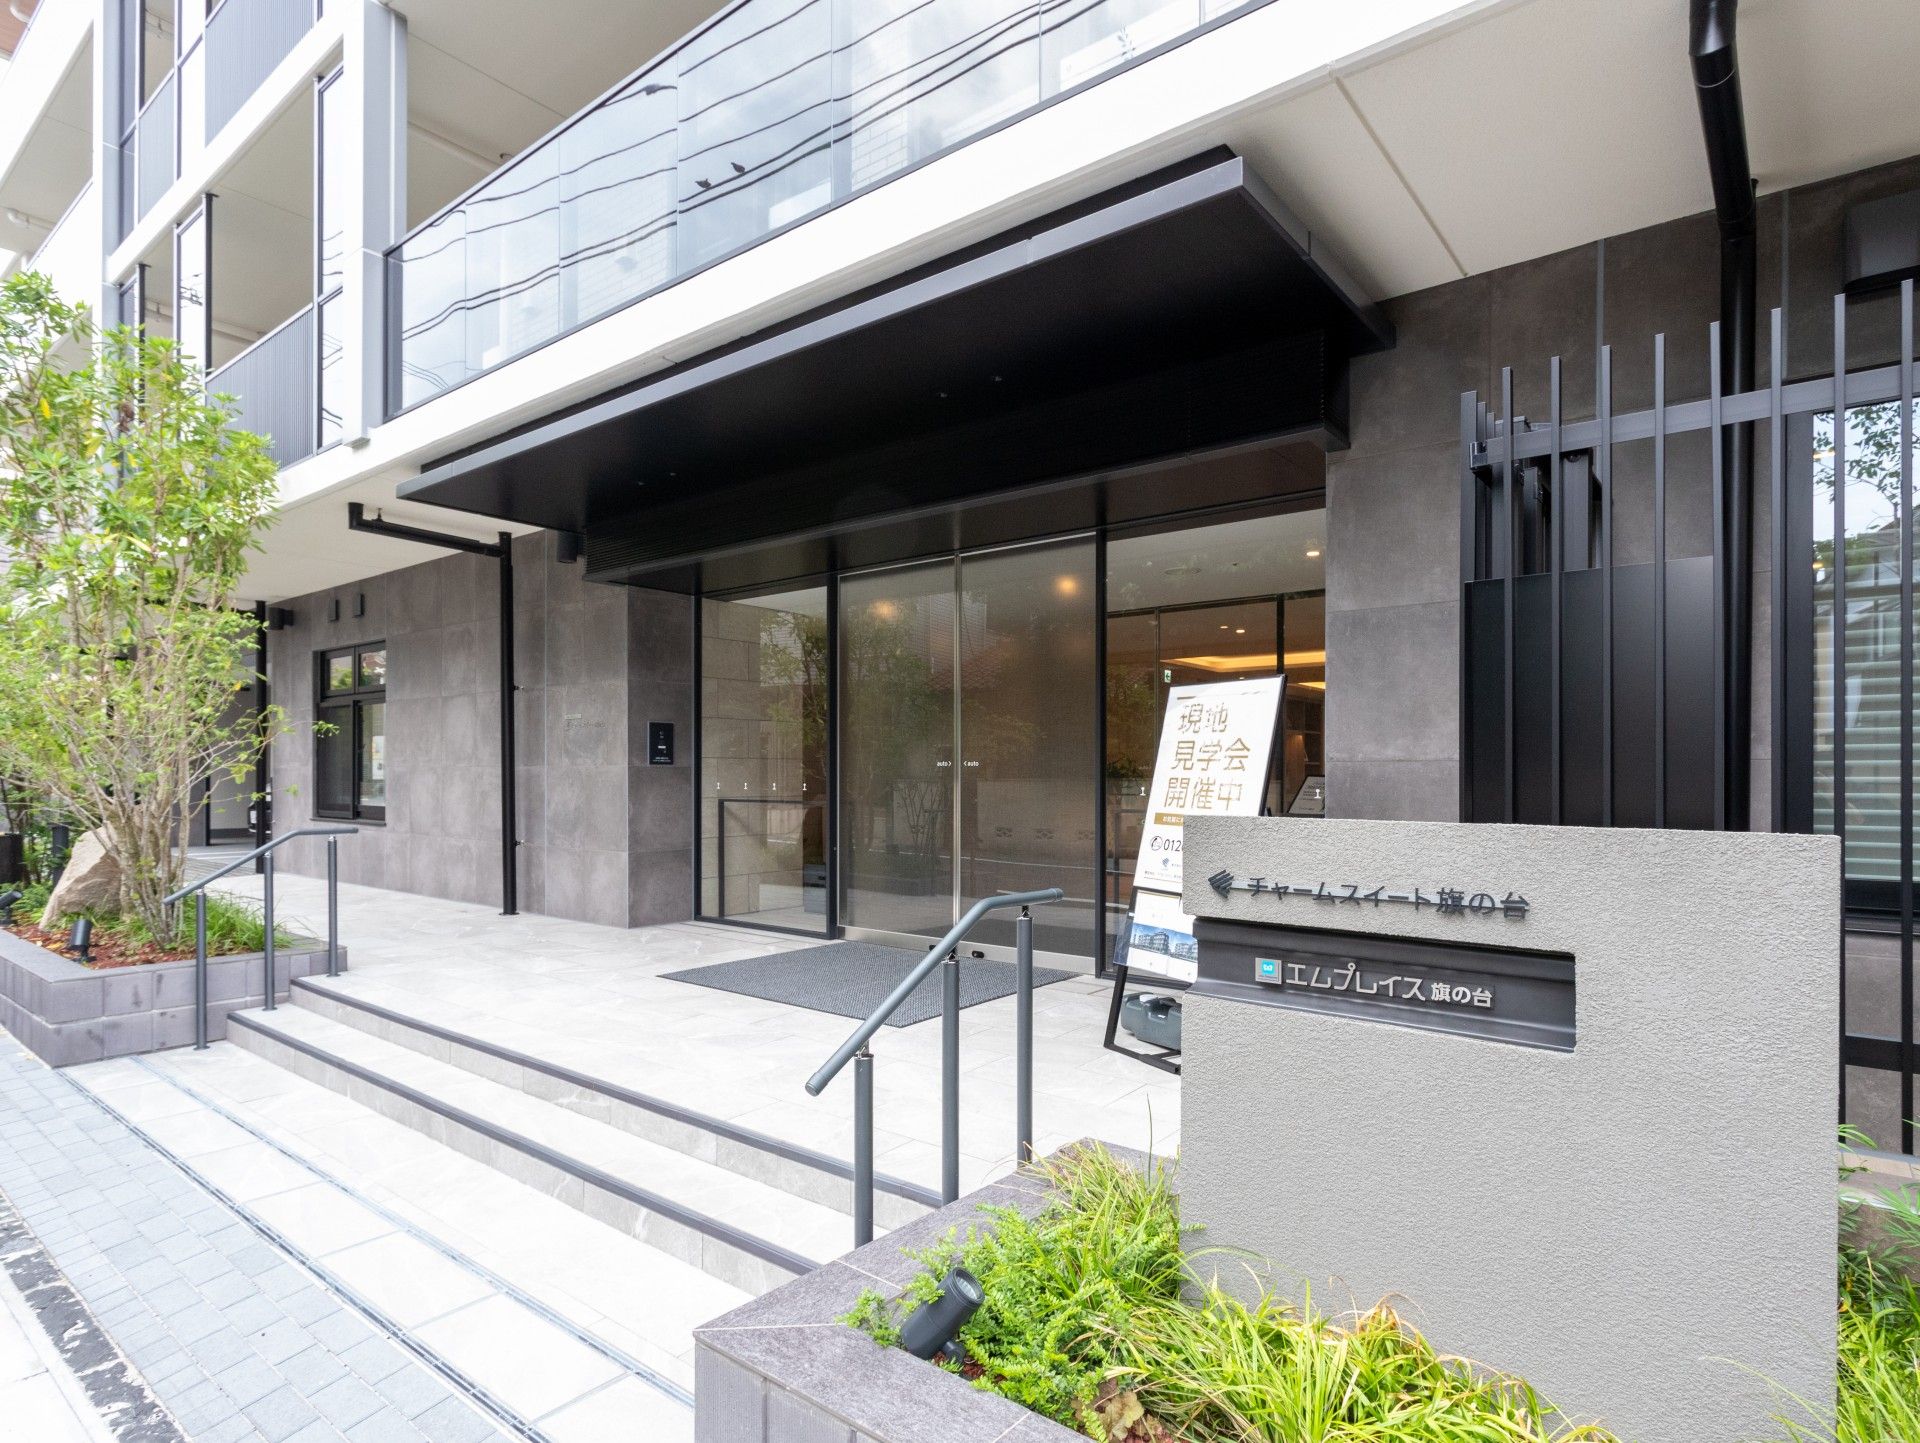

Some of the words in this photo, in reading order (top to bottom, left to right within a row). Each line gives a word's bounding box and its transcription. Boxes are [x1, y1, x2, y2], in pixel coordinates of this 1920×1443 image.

[1178, 702, 1228, 734] 現地
[1171, 738, 1250, 772] 見学会
[1164, 776, 1243, 811] 開催中
[1163, 838, 1183, 852] 012
[1247, 877, 1529, 919] チャームスイート旗の台
